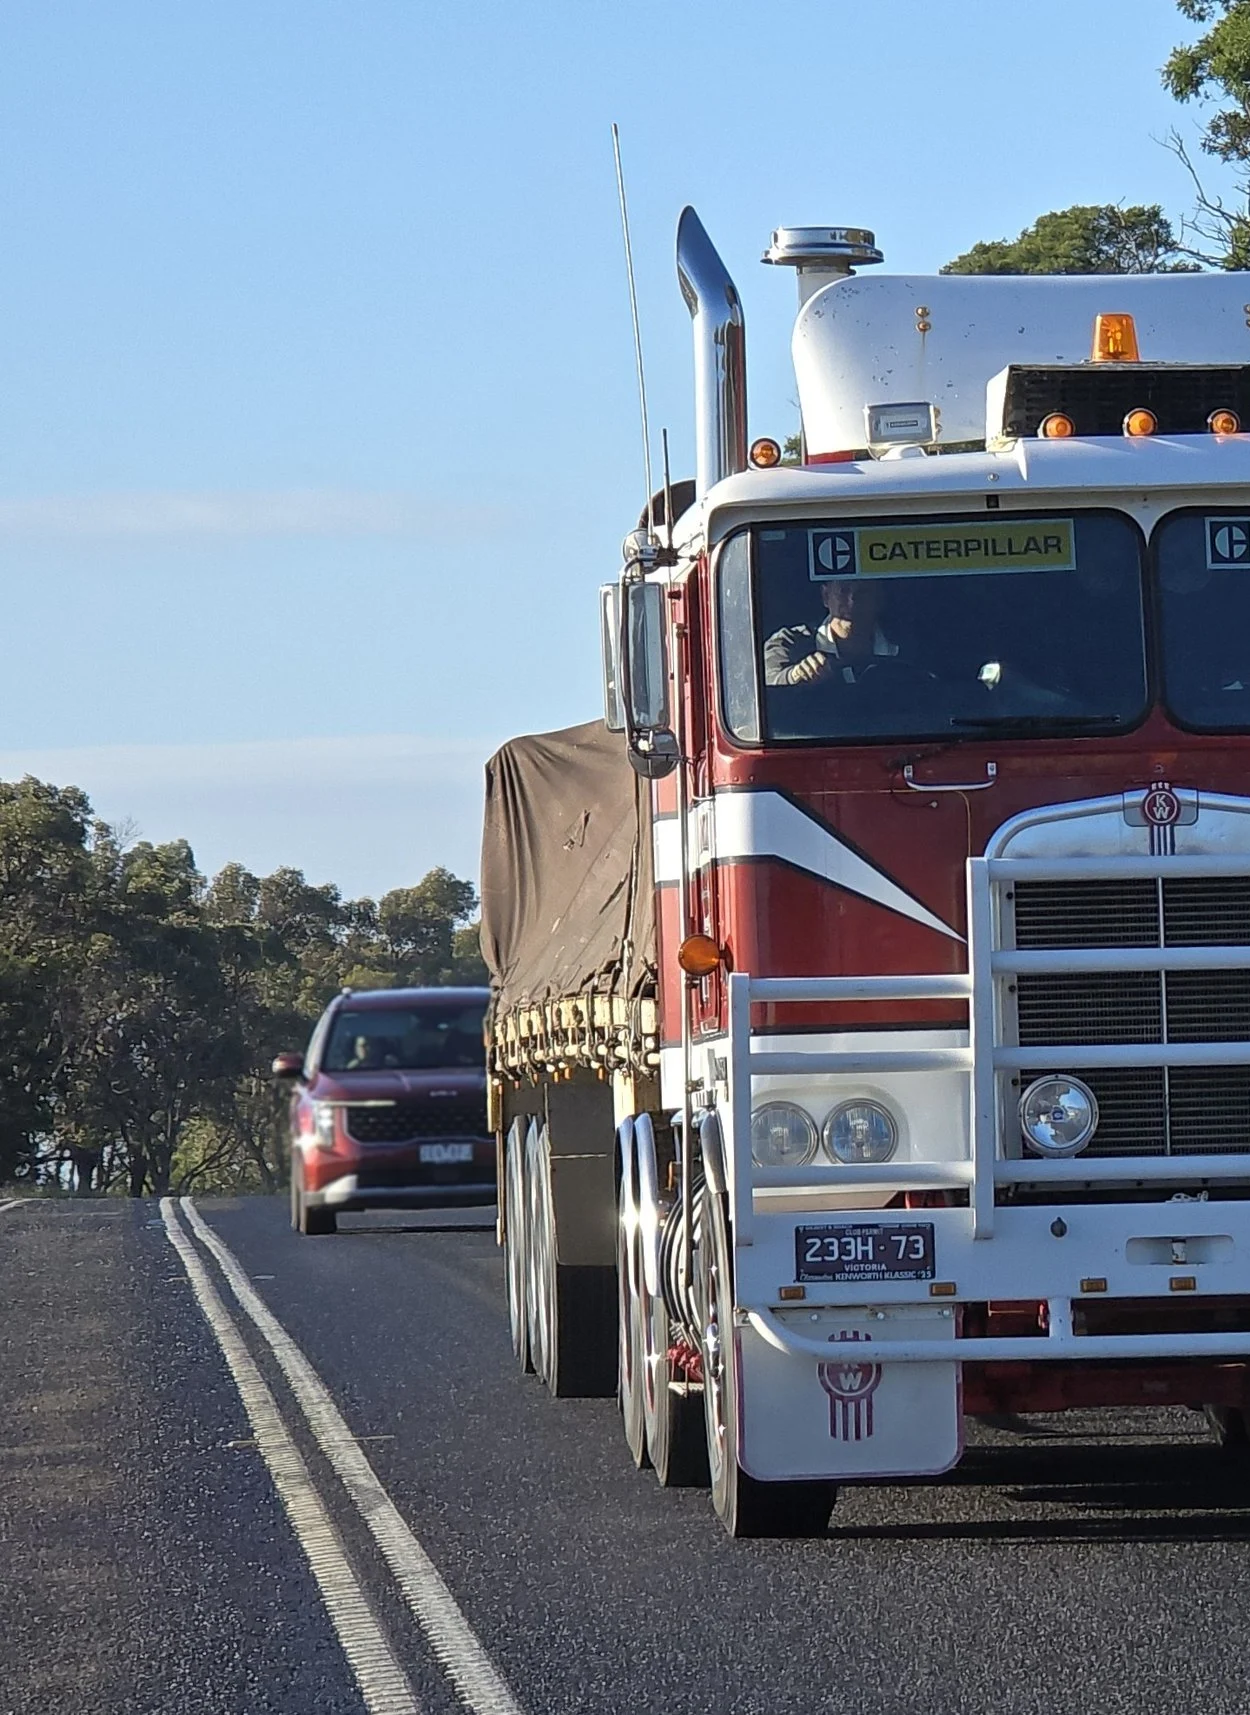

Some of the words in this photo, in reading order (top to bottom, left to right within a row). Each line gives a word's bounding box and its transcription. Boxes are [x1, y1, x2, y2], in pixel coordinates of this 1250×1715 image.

[868, 536, 1063, 561] CATERPILLAR
[1155, 795, 1167, 807] K
[1153, 807, 1170, 819] W
[805, 1236, 874, 1262] 233H
[890, 1235, 925, 1260] 73
[844, 1263, 887, 1271] VICTORIA
[835, 1272, 883, 1280] KENWORTH
[884, 1271, 916, 1279] KLASSIC
[839, 1371, 862, 1390] W
